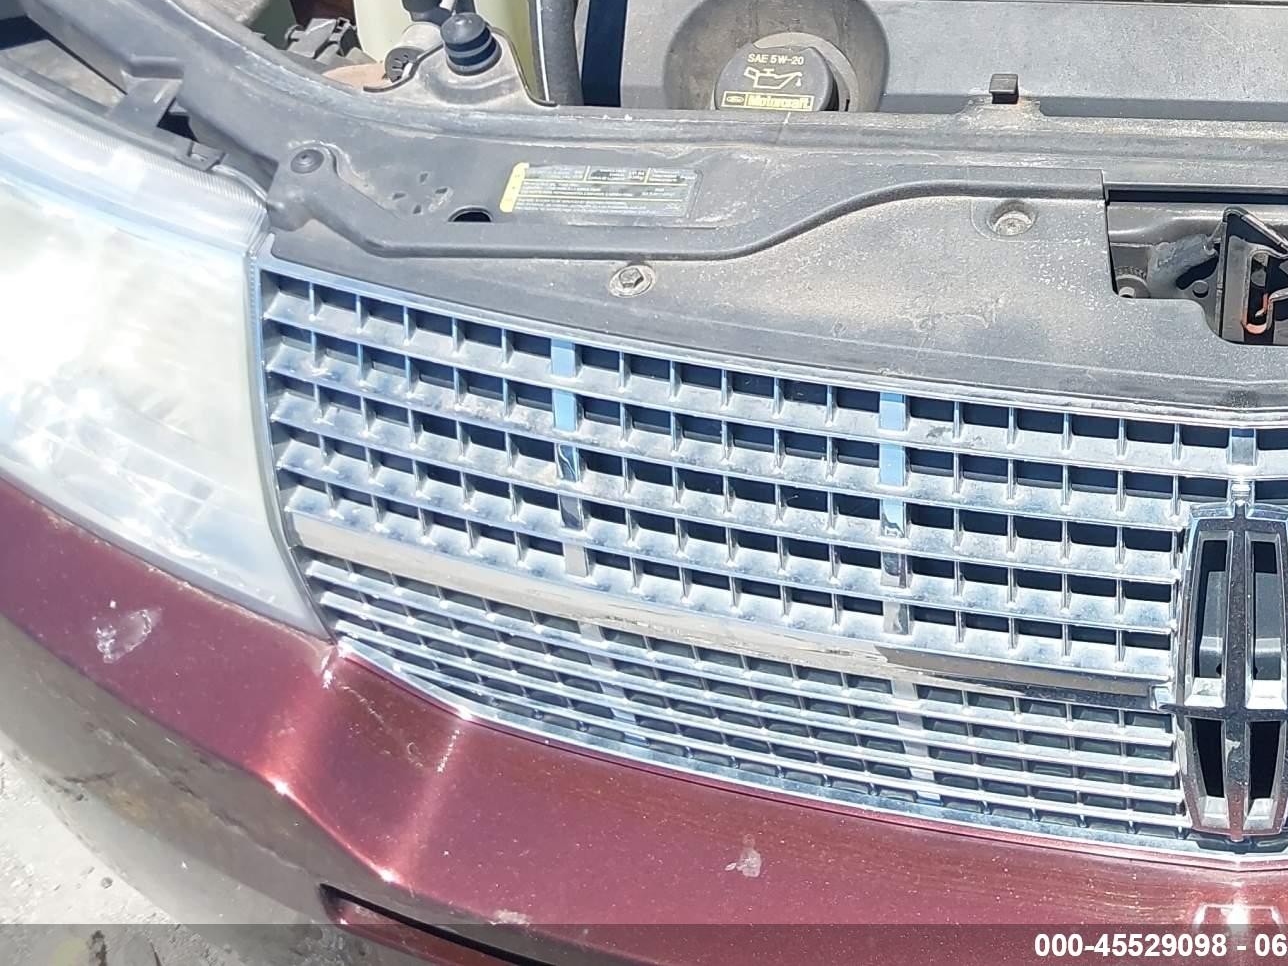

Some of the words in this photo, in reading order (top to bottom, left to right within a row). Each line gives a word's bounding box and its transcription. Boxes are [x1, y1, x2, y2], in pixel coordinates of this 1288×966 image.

[747, 53, 769, 64] SAE
[770, 54, 805, 65] 5W-20
[748, 94, 811, 110] Motorcraft
